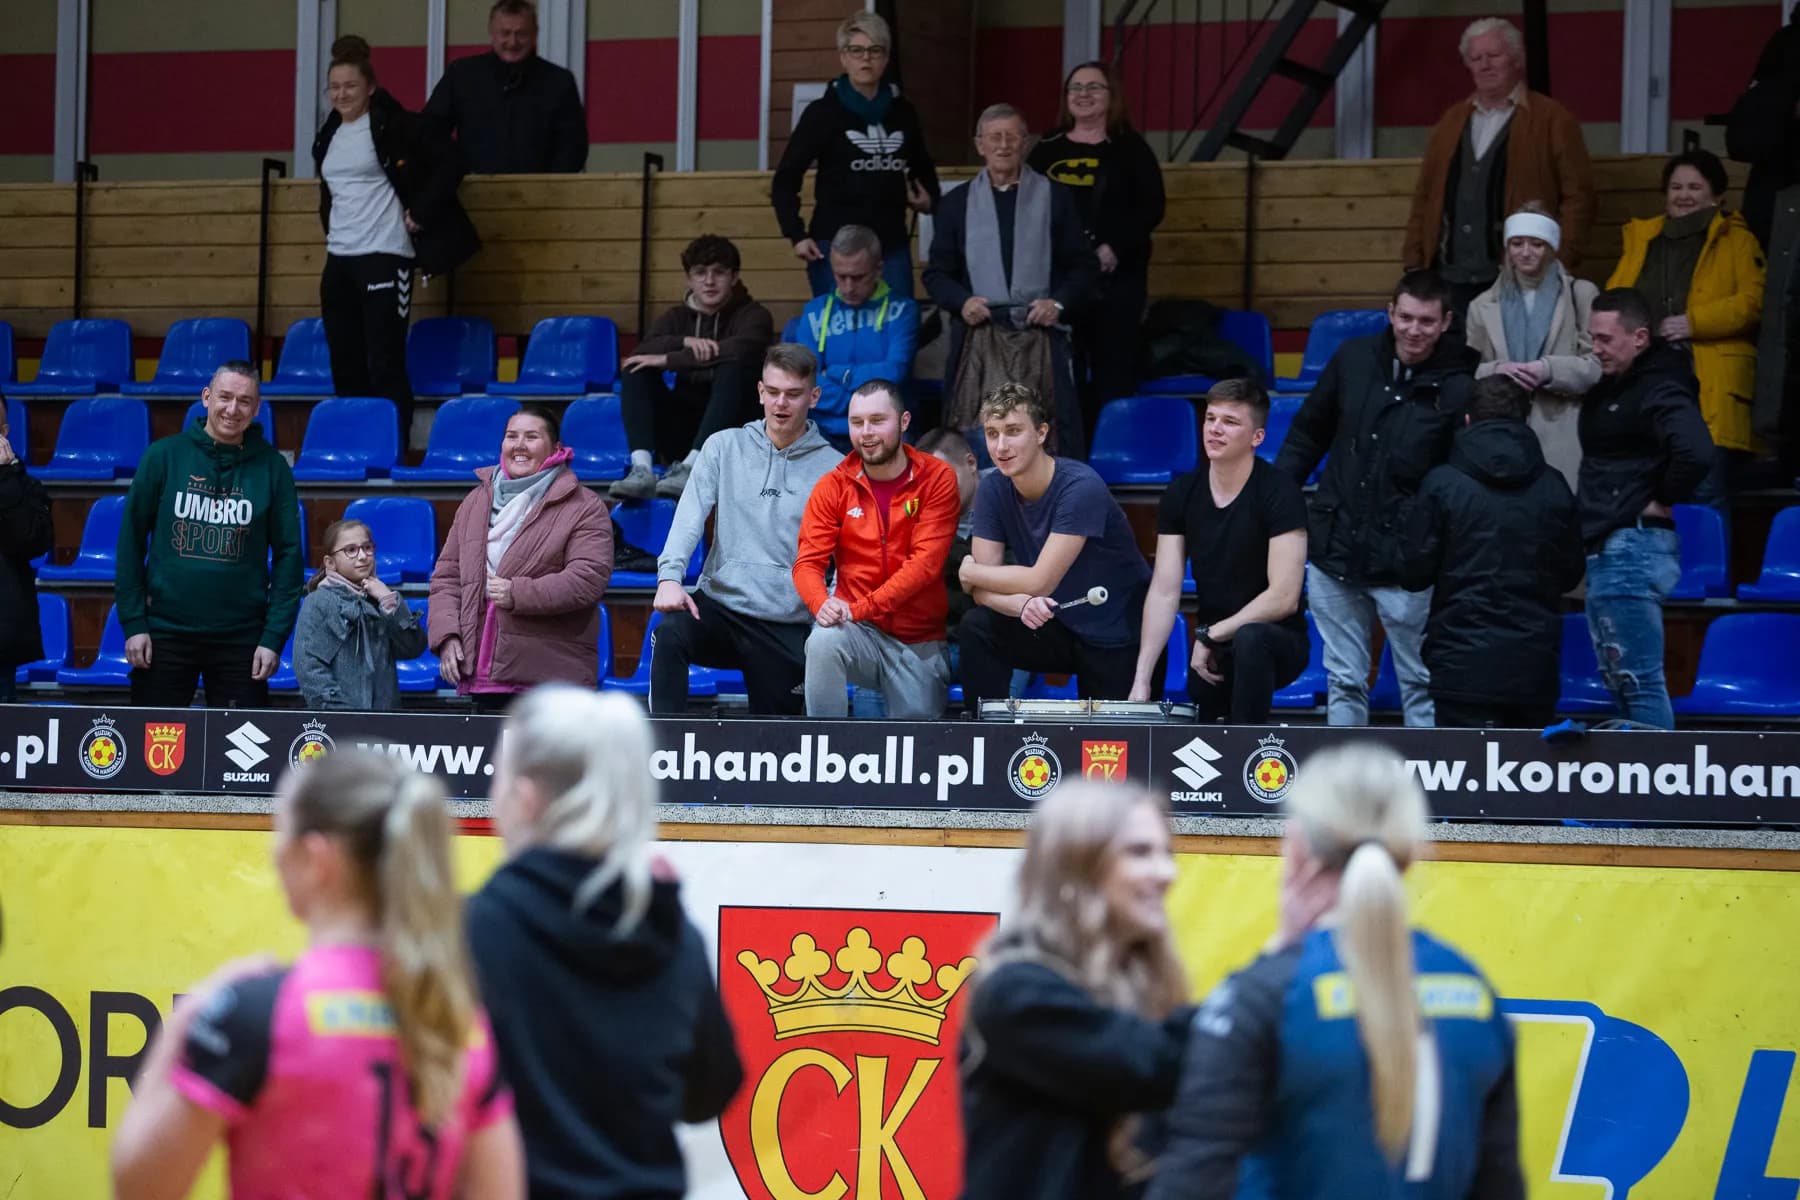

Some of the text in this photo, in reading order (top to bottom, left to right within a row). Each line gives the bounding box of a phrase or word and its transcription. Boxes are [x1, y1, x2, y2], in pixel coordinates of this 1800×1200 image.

[174, 491, 253, 525] UMBRO
[171, 519, 250, 557] SPORT
[0, 718, 59, 779] .pl
[148, 743, 177, 769] CK
[223, 772, 270, 783] SUZUKI
[1171, 791, 1222, 802] SUZUKI
[0, 985, 192, 1129] OR
[750, 1047, 944, 1200] CK
